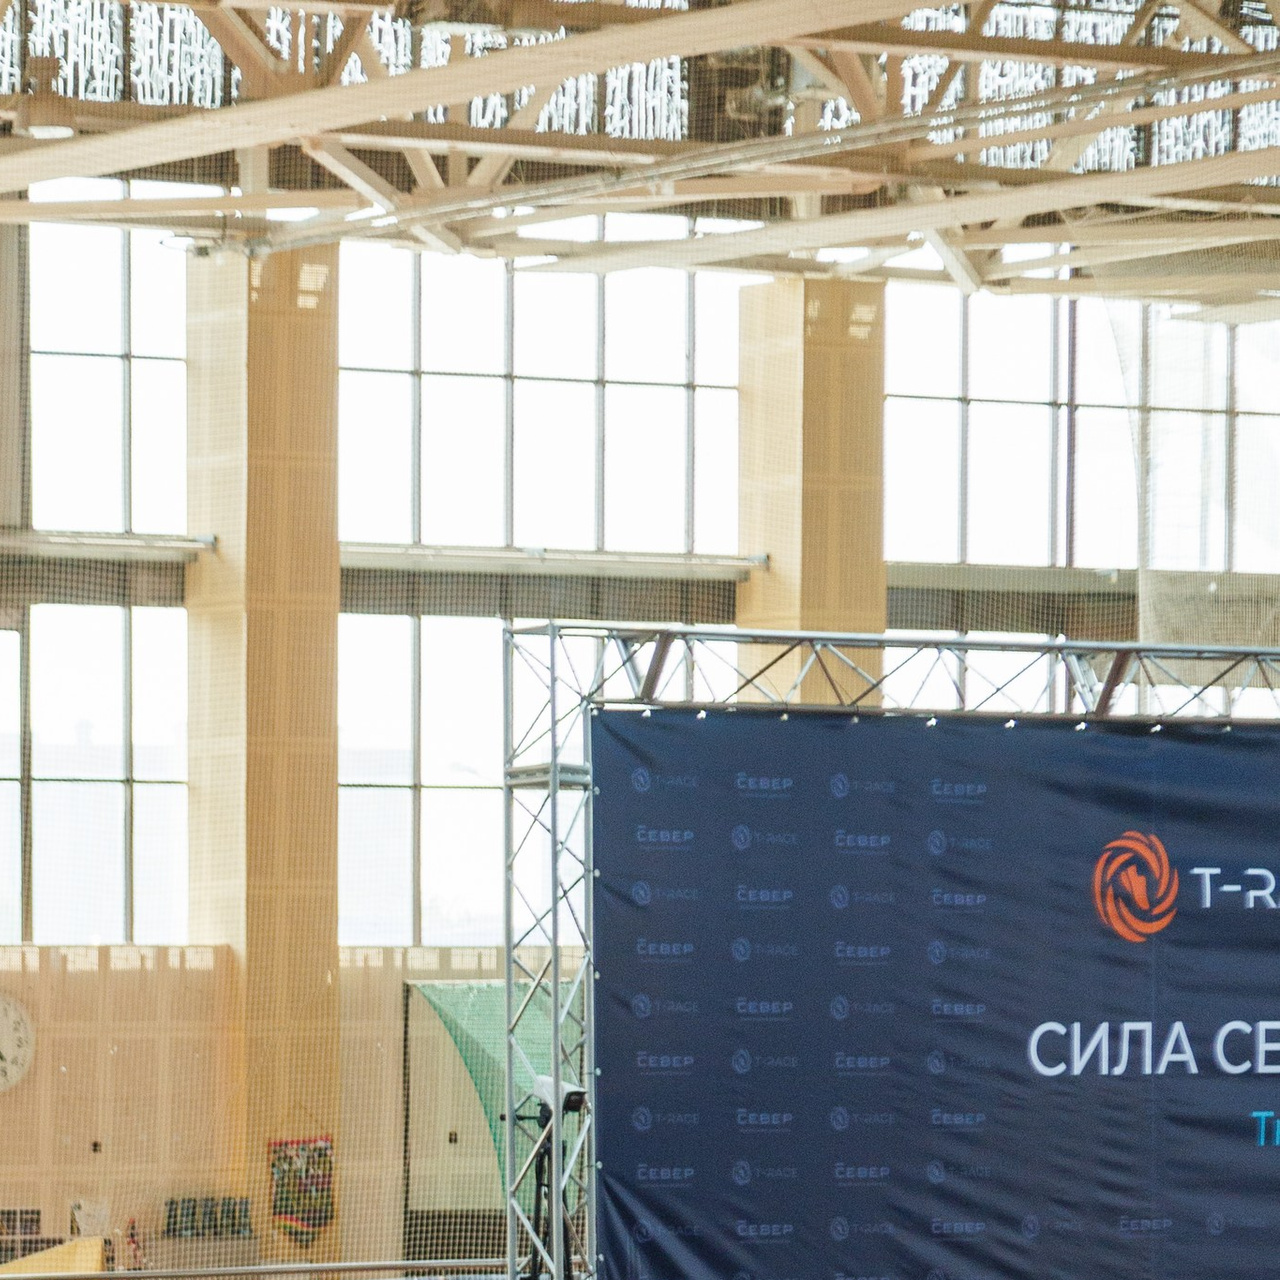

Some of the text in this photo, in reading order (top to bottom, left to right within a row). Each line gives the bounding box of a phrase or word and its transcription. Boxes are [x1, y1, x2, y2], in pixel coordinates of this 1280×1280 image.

[735, 773, 793, 790] СЕВЕР
[930, 779, 988, 796] СЕВЕР
[636, 826, 694, 843] СЕВЕР
[833, 831, 891, 848] СЕВЕР
[735, 885, 793, 902] СЕВЕР
[1189, 867, 1280, 909] T-R
[930, 889, 988, 906] СЕВЕР
[636, 939, 694, 956] СЕВЕР
[833, 941, 891, 958] СЕВЕР
[735, 997, 793, 1014] СЕВЕР
[1027, 1020, 1199, 1076] СИЛА
[636, 1051, 694, 1068] СЕВЕР
[833, 1052, 891, 1069] СЕВЕР
[735, 1109, 793, 1126] СЕВЕР
[636, 1164, 694, 1181] СЕВЕР
[833, 1162, 891, 1179] СЕВЕР
[736, 1220, 794, 1237] СЕВЕР
